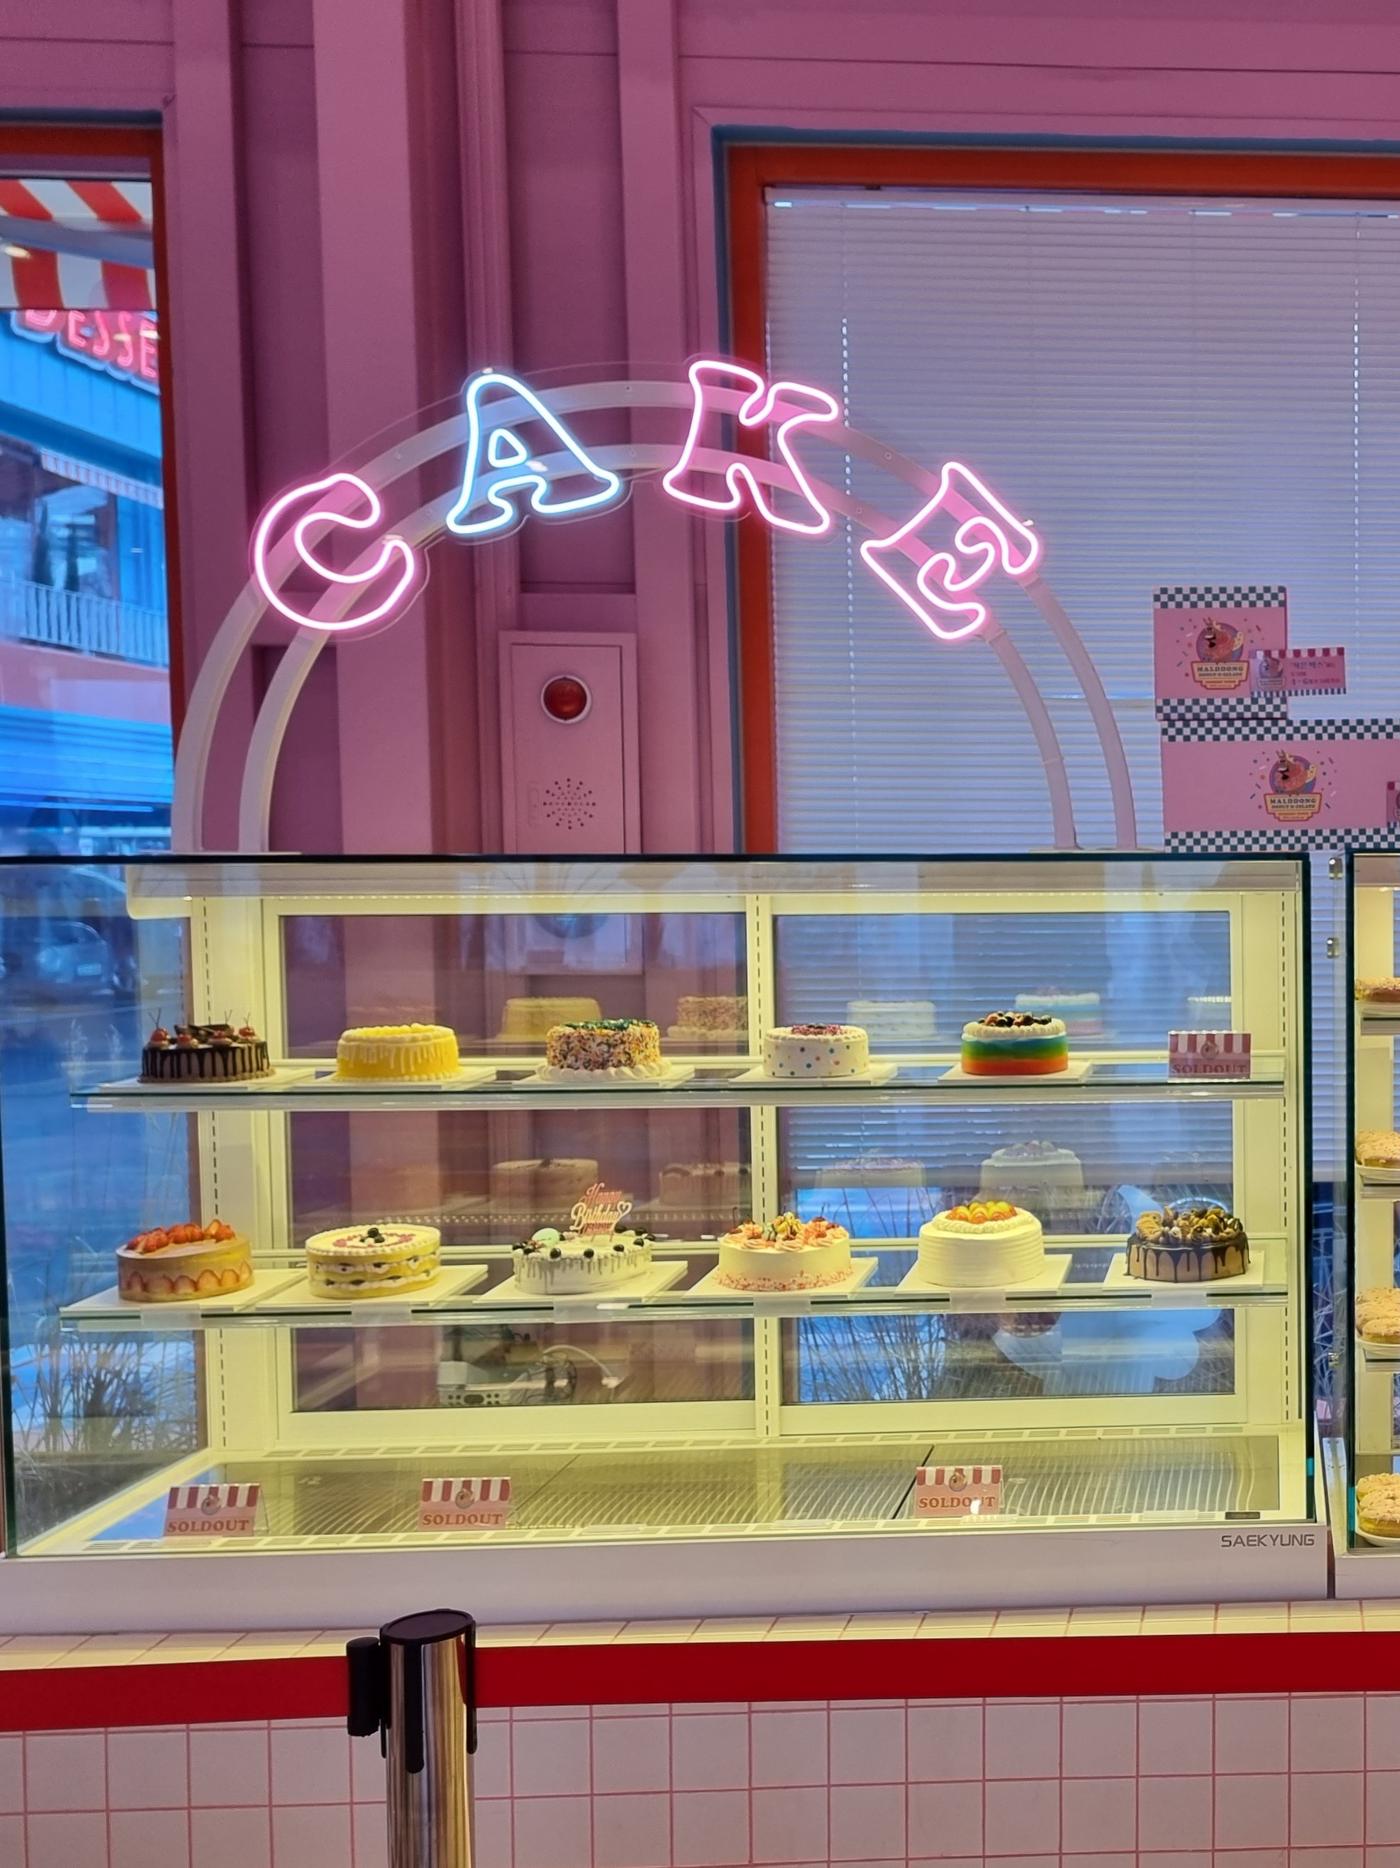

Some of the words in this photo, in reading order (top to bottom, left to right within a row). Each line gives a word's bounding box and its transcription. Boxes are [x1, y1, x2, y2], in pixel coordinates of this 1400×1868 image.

[254, 360, 1039, 640] CAKE
[167, 1519, 250, 1532] SOLDOUT
[422, 1513, 503, 1526] SOLDOUT
[1220, 1534, 1315, 1547] SAEKYUNG
